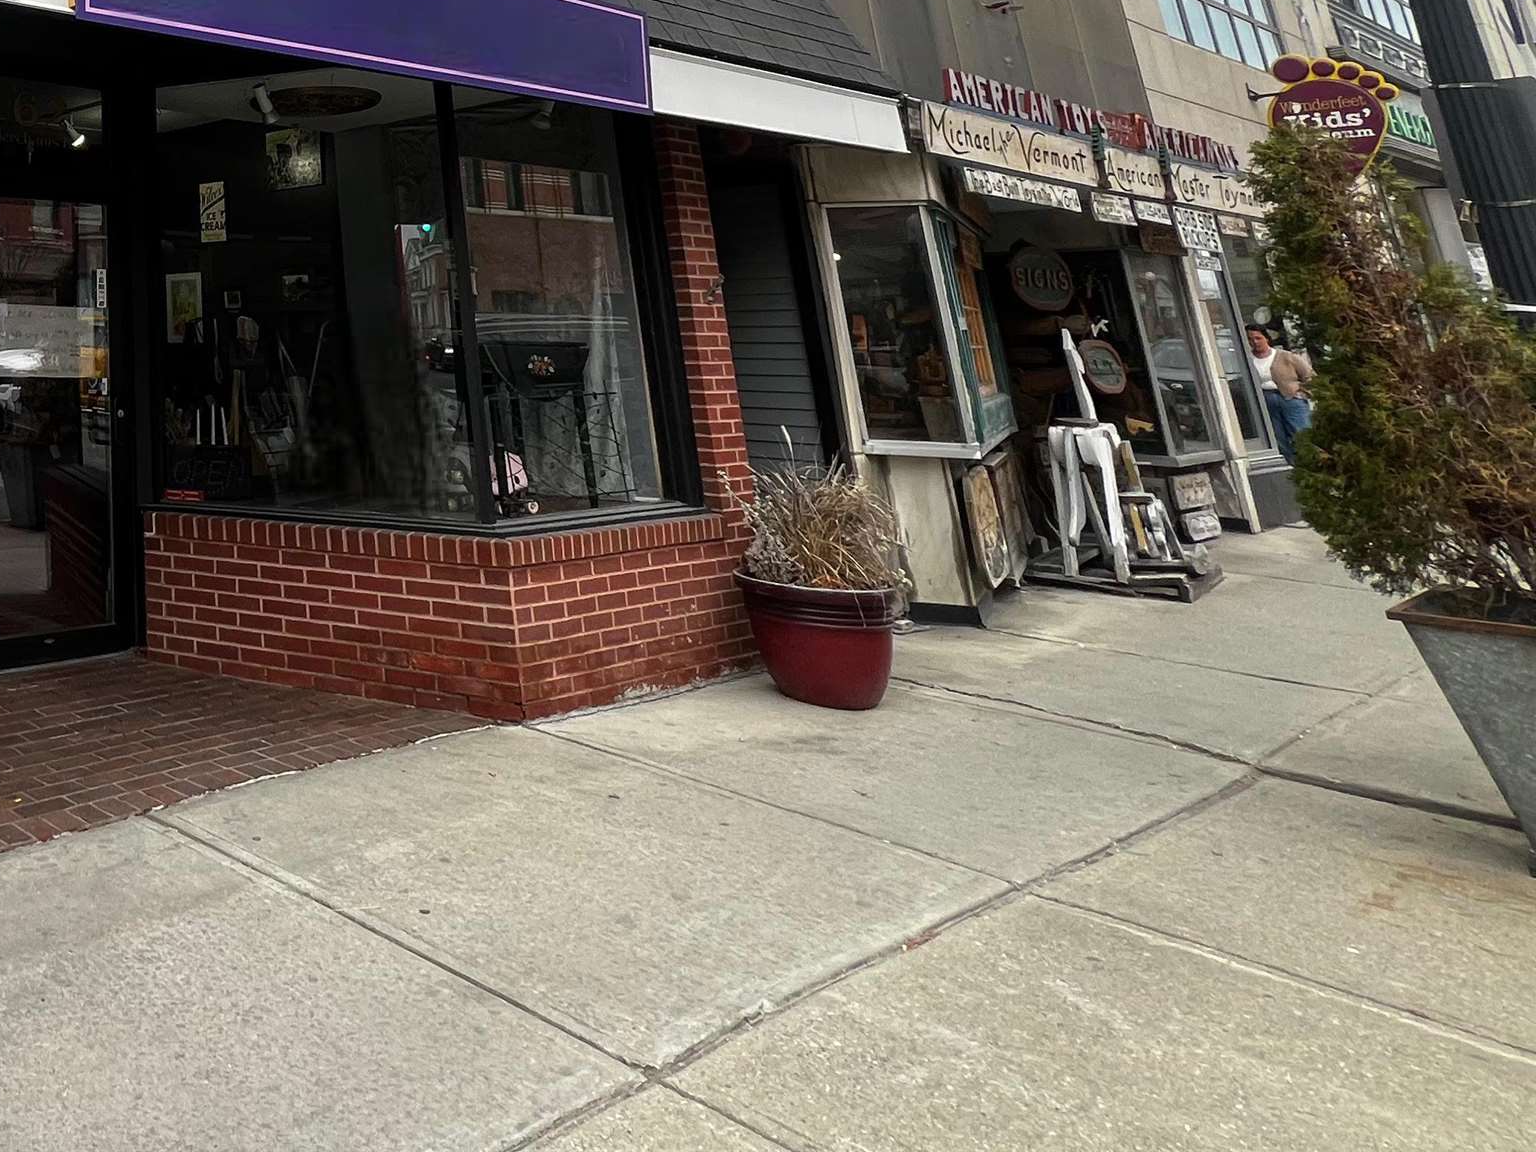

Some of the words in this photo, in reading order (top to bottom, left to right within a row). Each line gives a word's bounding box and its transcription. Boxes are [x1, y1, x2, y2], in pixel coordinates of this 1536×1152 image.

[944, 67, 1055, 126] AMERICAN
[1058, 98, 1109, 140] TOYS
[1279, 95, 1367, 114] Wonderfeet
[926, 103, 997, 155] Michael
[1010, 124, 1087, 174] Vermont
[1106, 150, 1162, 191] American
[1014, 266, 1069, 291] SIGNS
